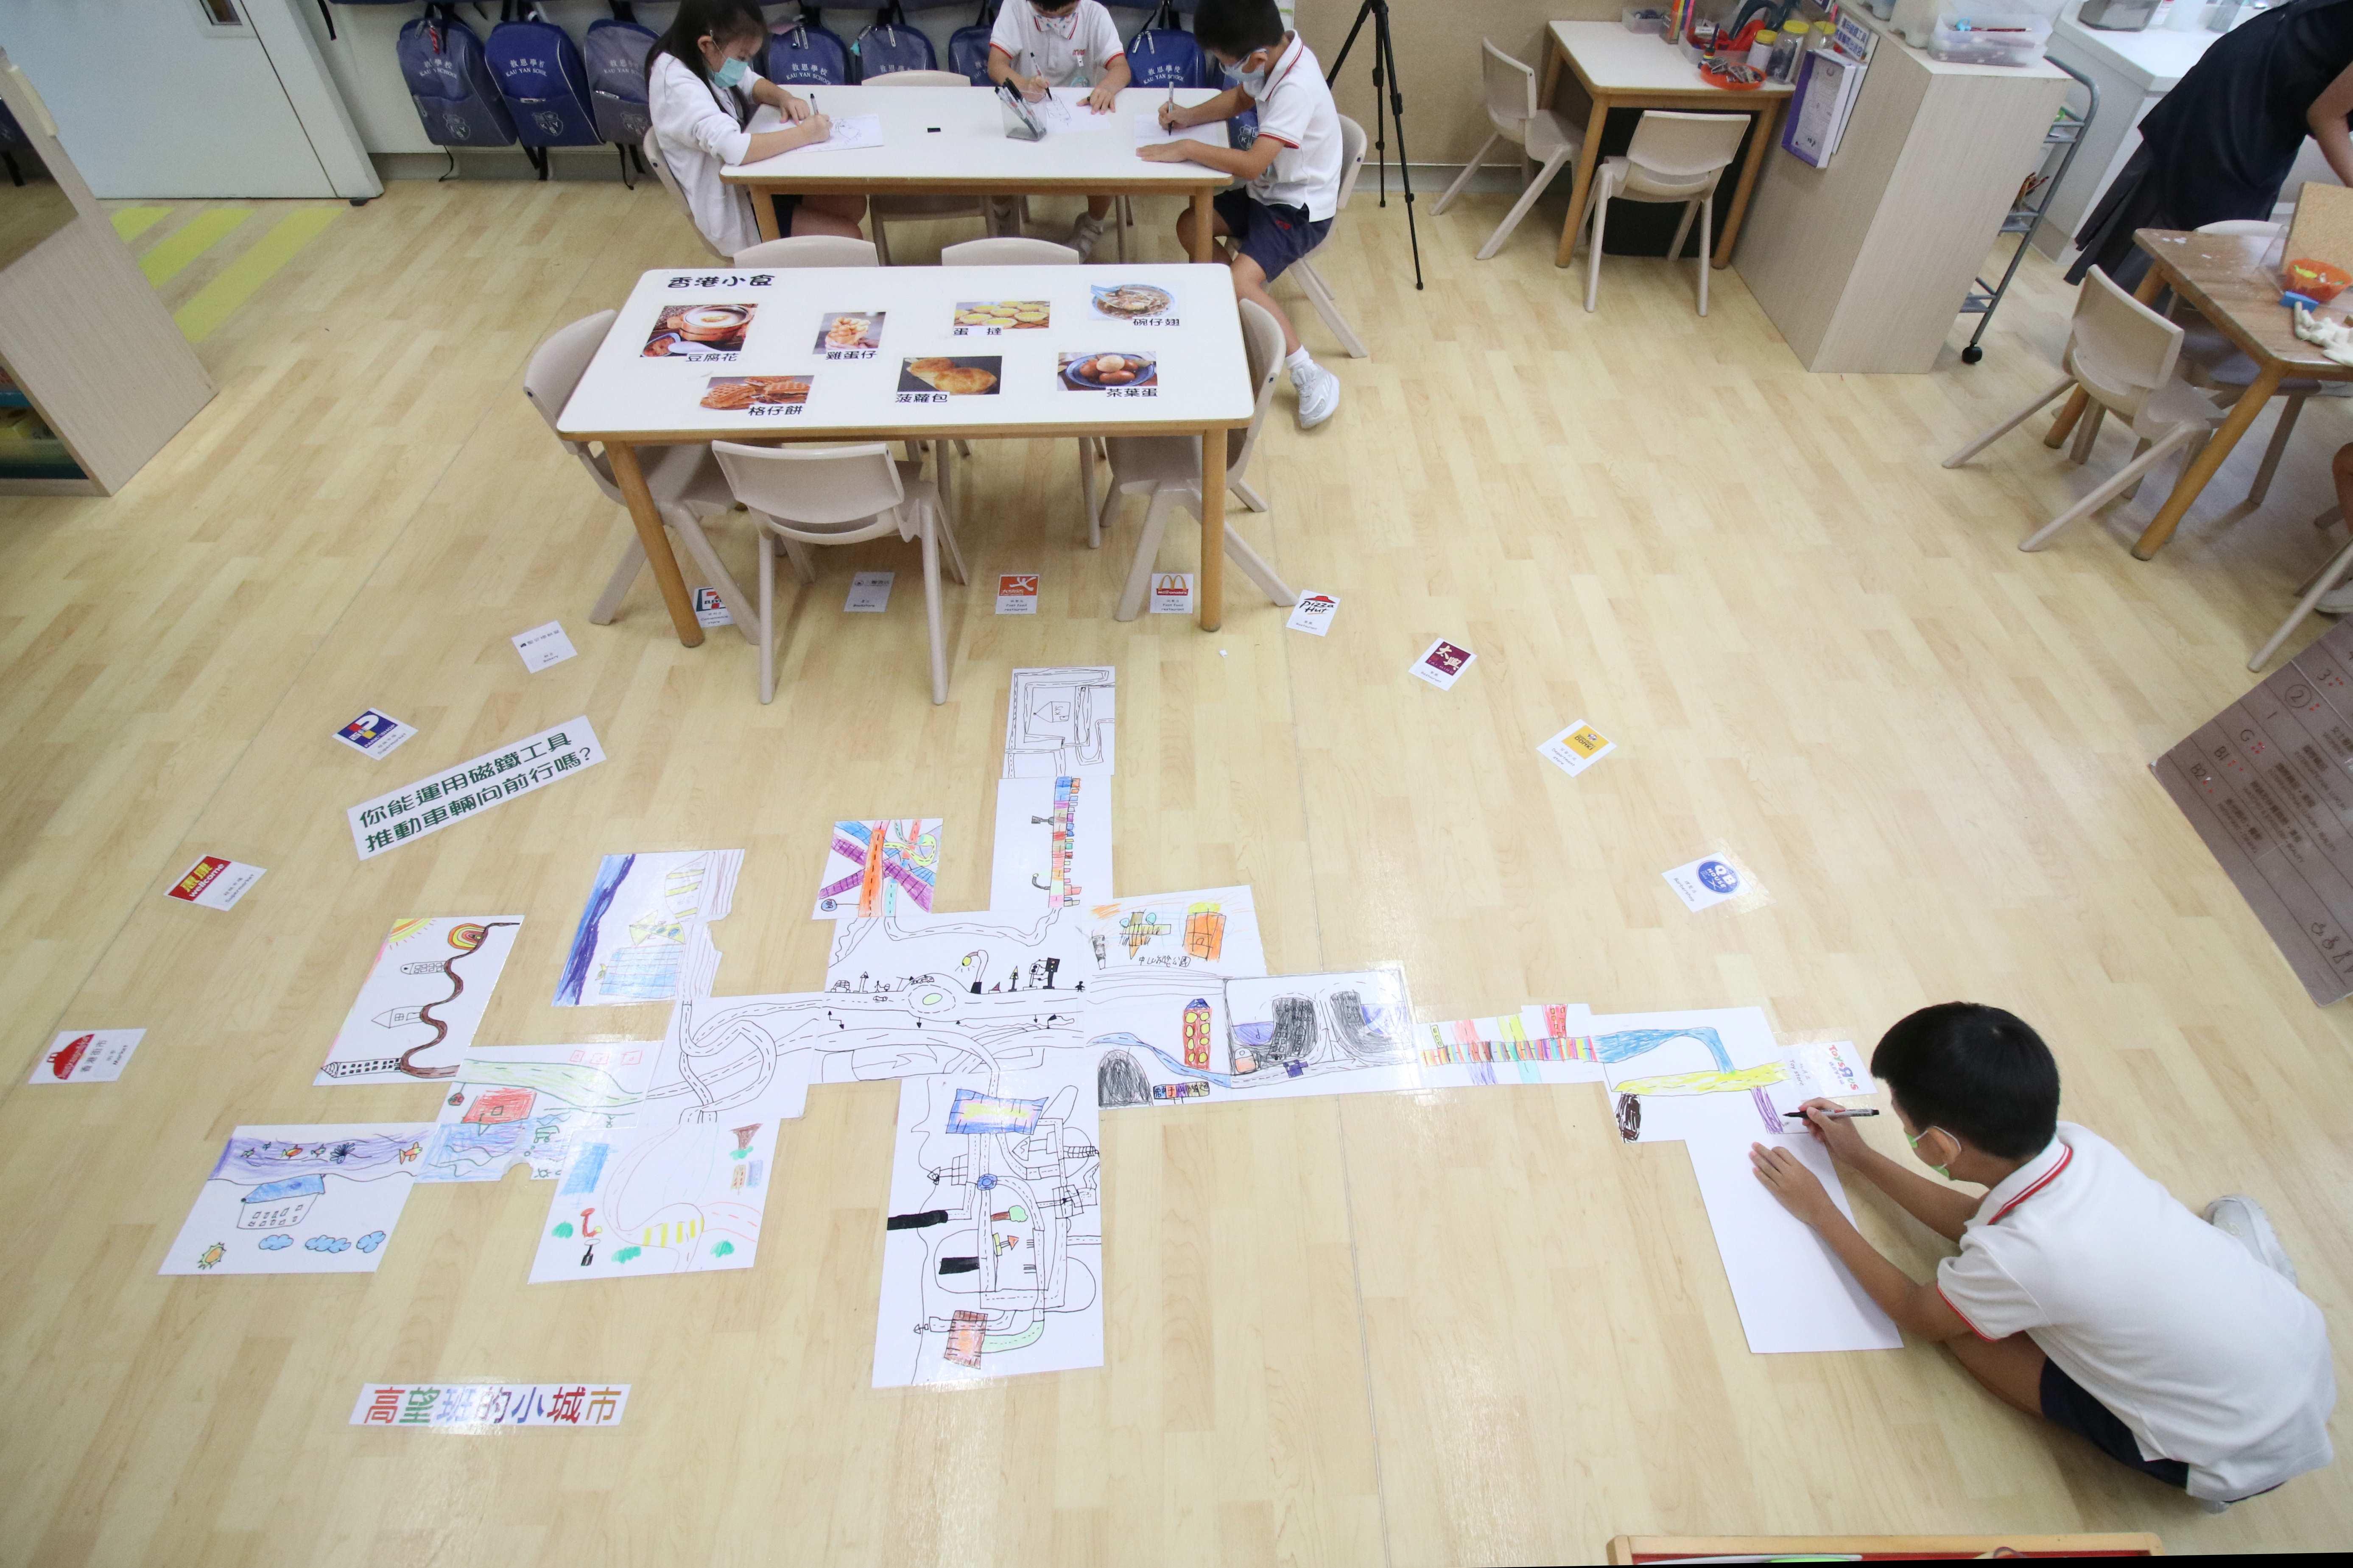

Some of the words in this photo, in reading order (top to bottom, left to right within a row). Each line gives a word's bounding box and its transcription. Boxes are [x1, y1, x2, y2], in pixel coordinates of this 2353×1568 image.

[786, 73, 798, 81] KAU
[1143, 77, 1154, 85] KAU
[667, 274, 776, 288] 香港小食
[1133, 318, 1180, 327] 碗仔翅
[685, 353, 739, 363] 豆腐花
[825, 350, 877, 360] 雞蛋仔
[895, 393, 948, 404] 菠蘿包
[1107, 388, 1158, 398] 茶葉蛋
[748, 405, 803, 416] 格仔餅
[1299, 600, 1334, 608] Pizza
[2241, 729, 2255, 742] G
[1574, 736, 1593, 751] DONKI
[2191, 763, 2206, 778] B2
[359, 733, 572, 828] 你能運用磁鐵工具
[189, 863, 224, 898] wellcome
[1707, 868, 1726, 889] HOUSE
[1715, 865, 1737, 885] QB
[364, 1387, 622, 1424] 高望班的小城市
